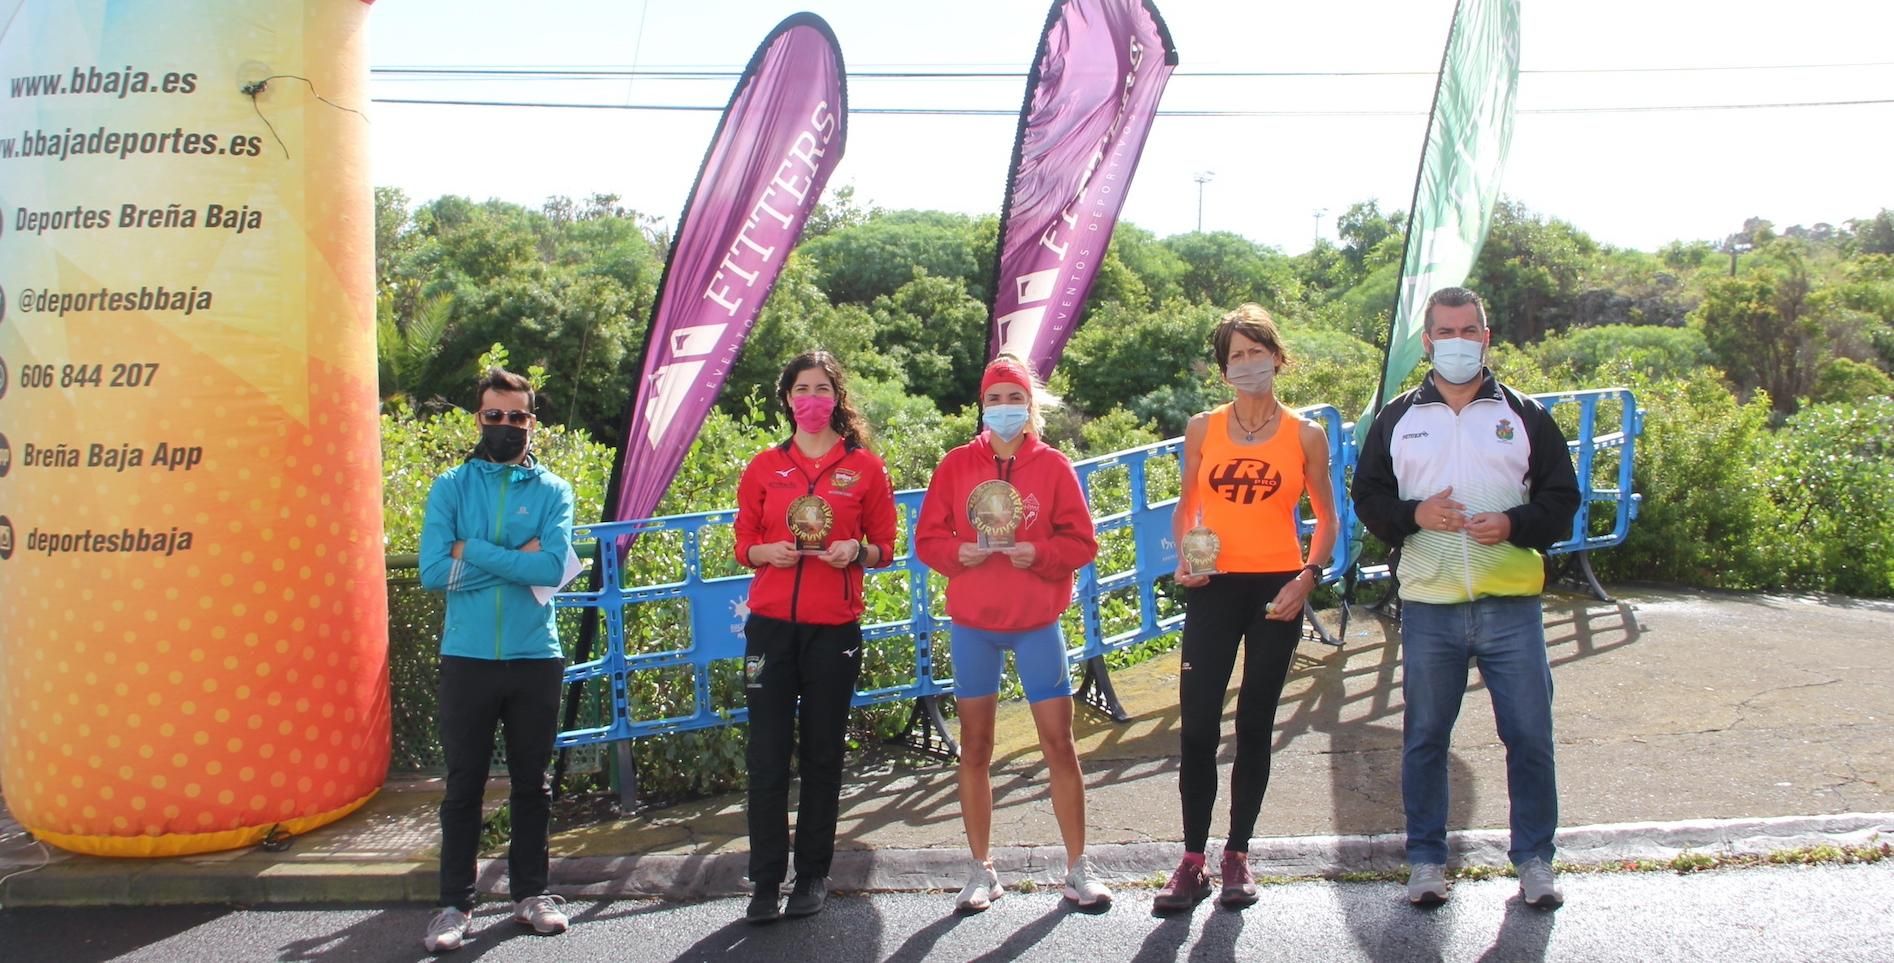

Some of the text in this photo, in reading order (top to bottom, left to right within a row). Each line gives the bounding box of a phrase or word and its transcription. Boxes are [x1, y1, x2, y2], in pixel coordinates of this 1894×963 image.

[11, 65, 198, 98] www.bbaja.es
[0, 127, 262, 160] w.bbajadeportes.es
[15, 203, 262, 236] Deportes Breña Baja
[703, 100, 836, 317] FITTERS
[19, 286, 213, 317] @deportesbbaja
[1053, 248, 1090, 332] EVENTOS
[20, 363, 160, 388] 606 844 207
[23, 443, 203, 472] Breña Baja App
[1214, 459, 1278, 479] TRI
[1217, 484, 1273, 504] FIT
[972, 516, 1016, 536] SURVIVE
[1009, 487, 1023, 520] TRAIL
[27, 527, 193, 556] deportesbbaja
[790, 523, 827, 541] SURVIVE
